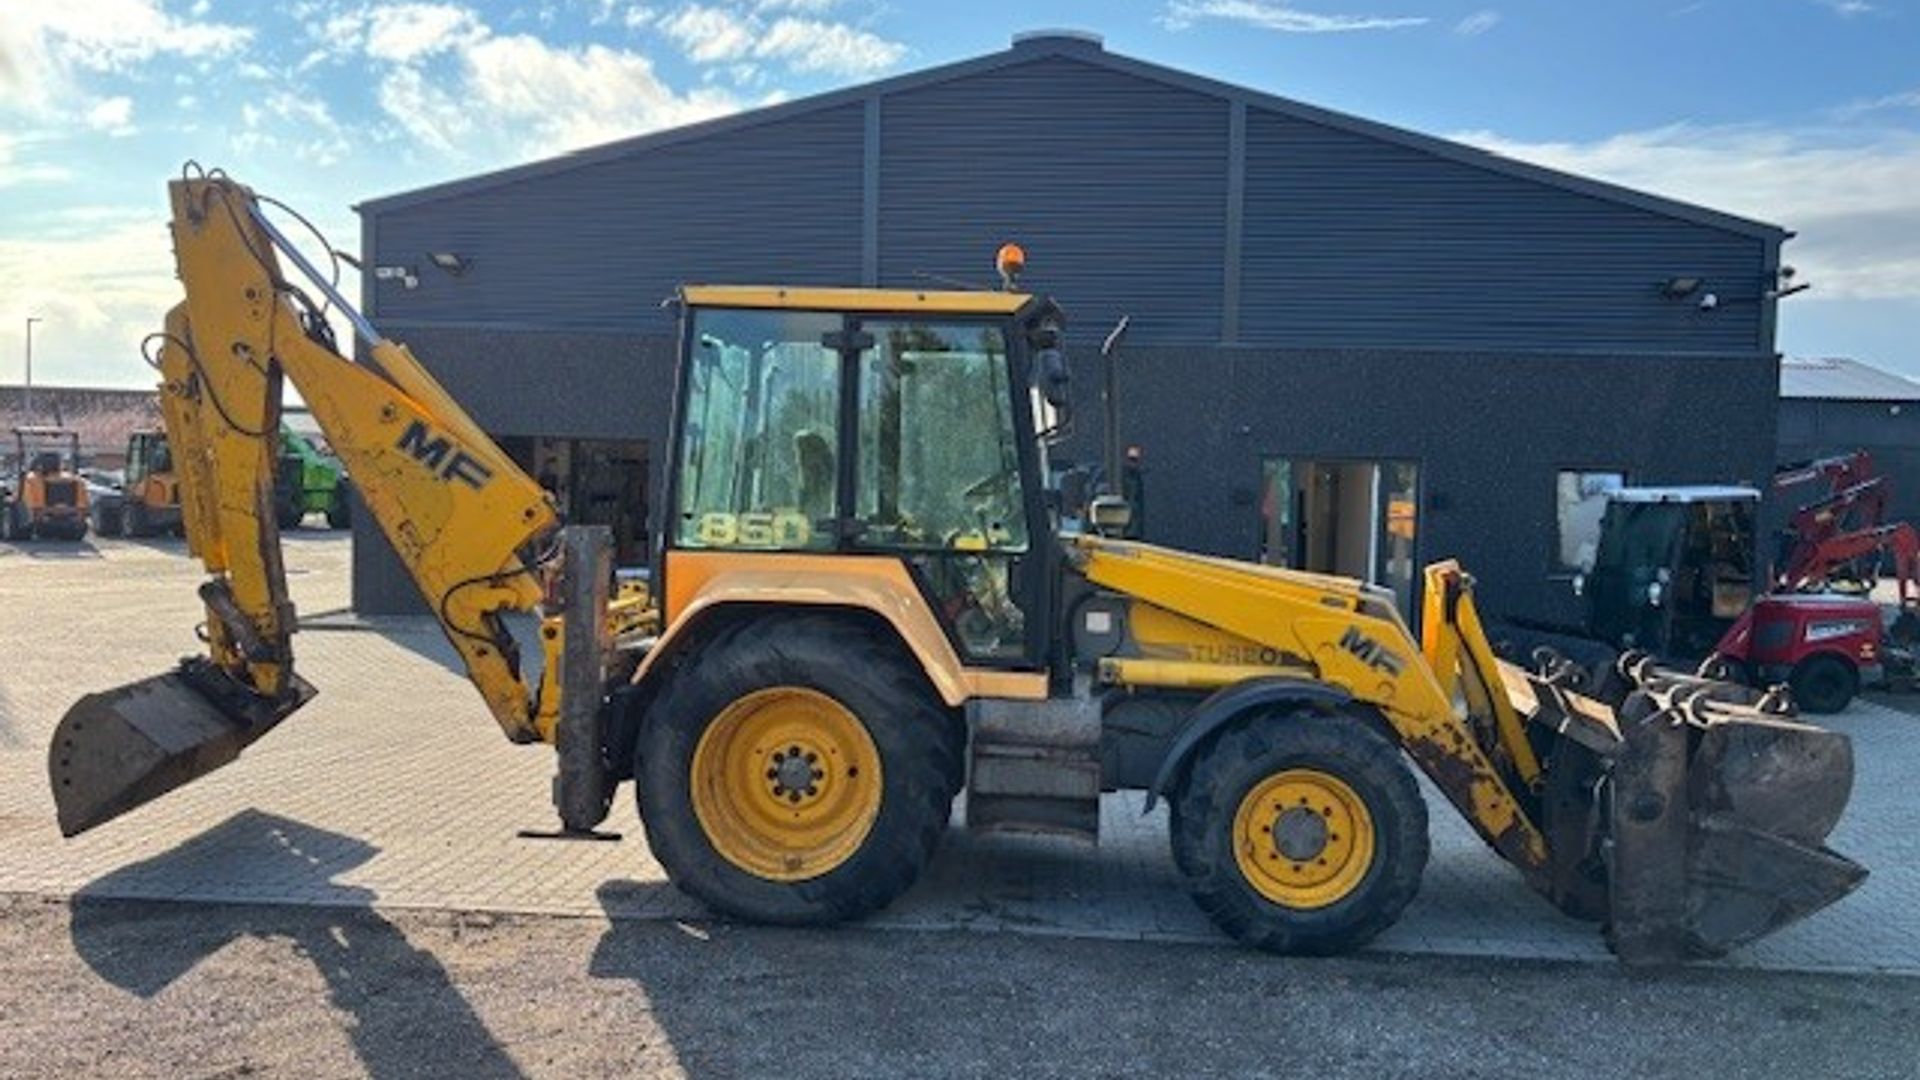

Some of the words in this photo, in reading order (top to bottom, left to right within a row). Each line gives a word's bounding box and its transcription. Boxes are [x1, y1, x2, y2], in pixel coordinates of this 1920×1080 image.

[396, 418, 492, 490] MF
[700, 511, 809, 545] 850
[1190, 645, 1276, 665] TURBO
[1338, 625, 1402, 677] MF
